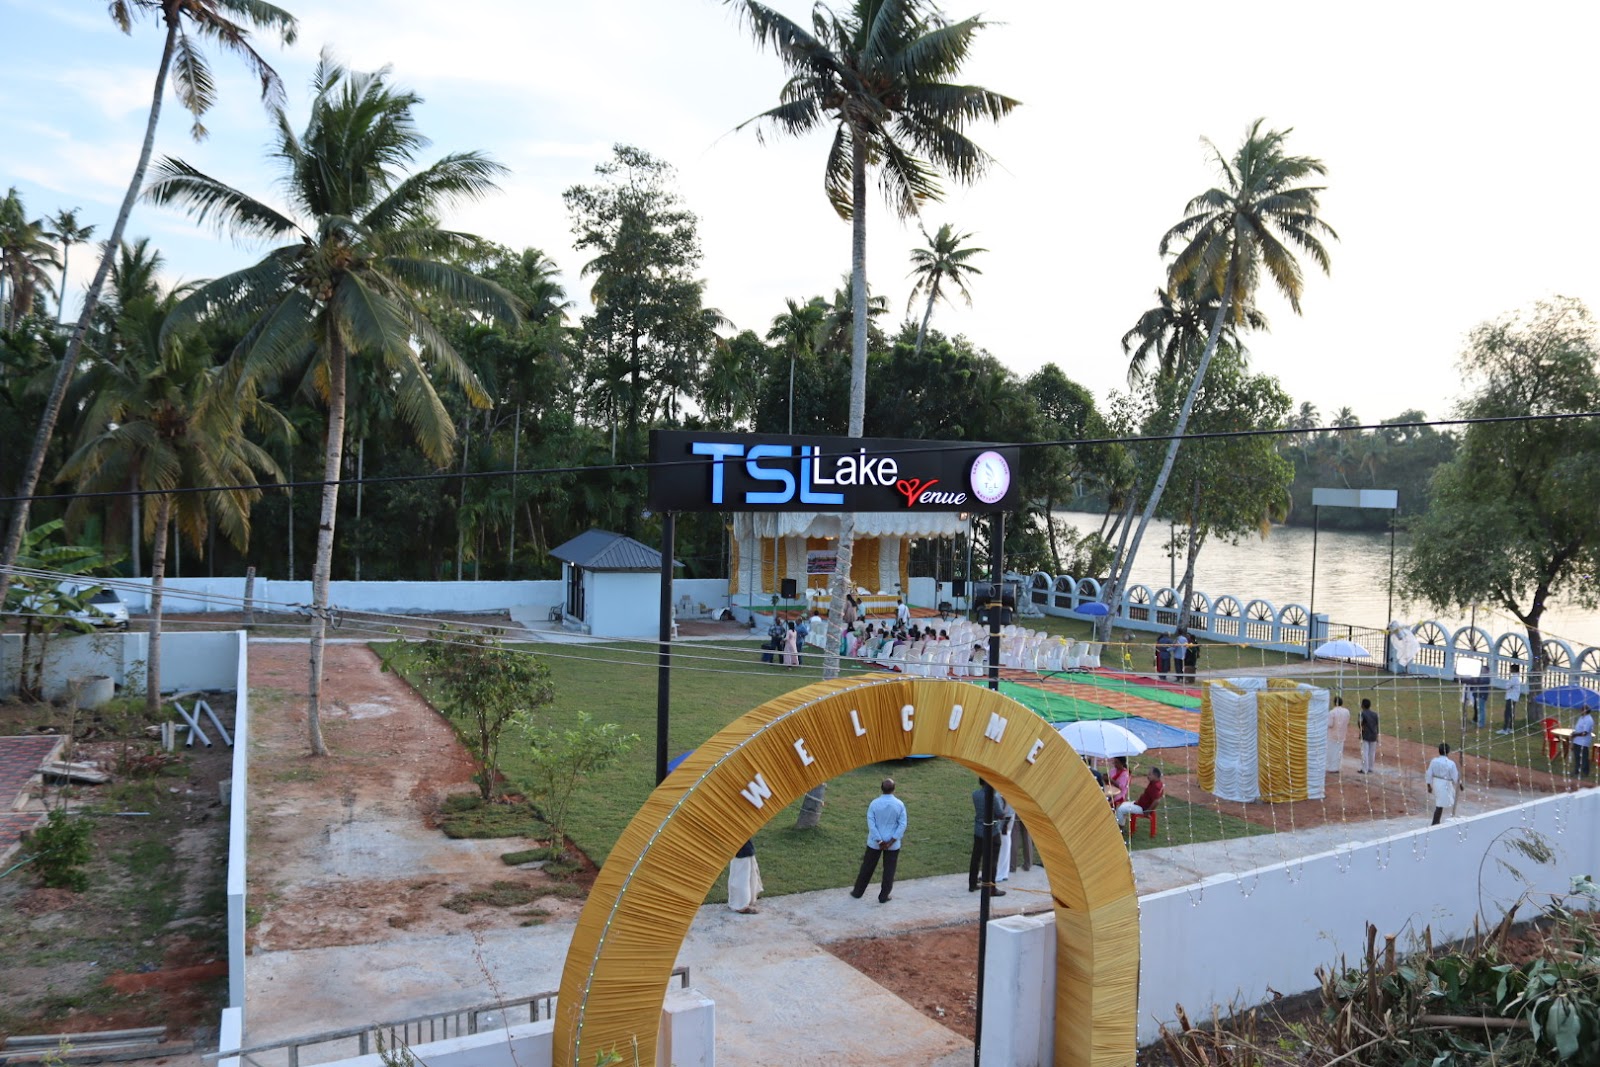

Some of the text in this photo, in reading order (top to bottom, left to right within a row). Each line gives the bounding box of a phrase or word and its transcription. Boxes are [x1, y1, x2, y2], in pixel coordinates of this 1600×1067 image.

[692, 442, 898, 504] TSL Lake
[896, 478, 967, 507] Venue
[740, 704, 1045, 810] WELCOME
